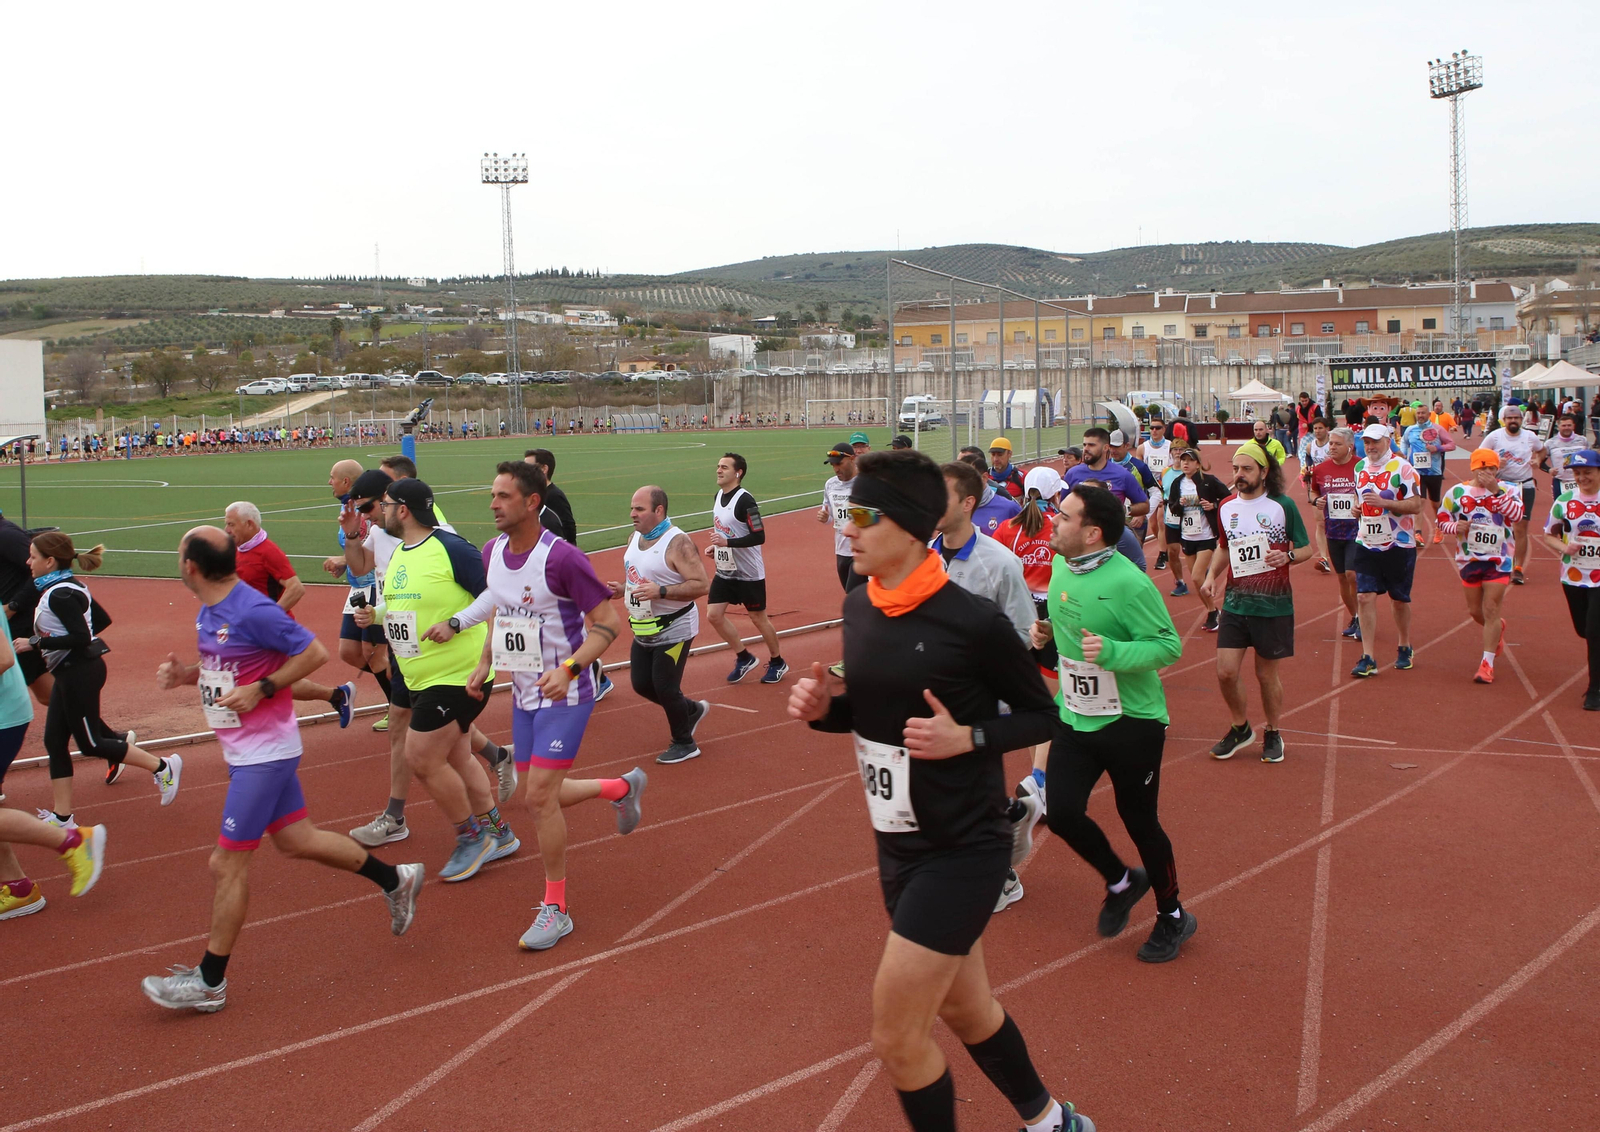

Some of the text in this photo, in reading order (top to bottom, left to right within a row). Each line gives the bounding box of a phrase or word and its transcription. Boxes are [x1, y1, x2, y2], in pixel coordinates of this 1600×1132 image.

[1352, 363, 1493, 383] MILAR LUCENA
[1361, 381, 1409, 389] TECNOLOGÍAS
[1416, 378, 1494, 388] ELECTRODOMÉSTICOS
[1332, 500, 1351, 510] 600
[1183, 517, 1193, 526] 50
[1475, 531, 1497, 545] 860
[1238, 545, 1261, 562] 327
[1579, 545, 1600, 557] 834
[388, 622, 409, 641] 686
[505, 632, 526, 652] 60
[1069, 673, 1099, 696] 757
